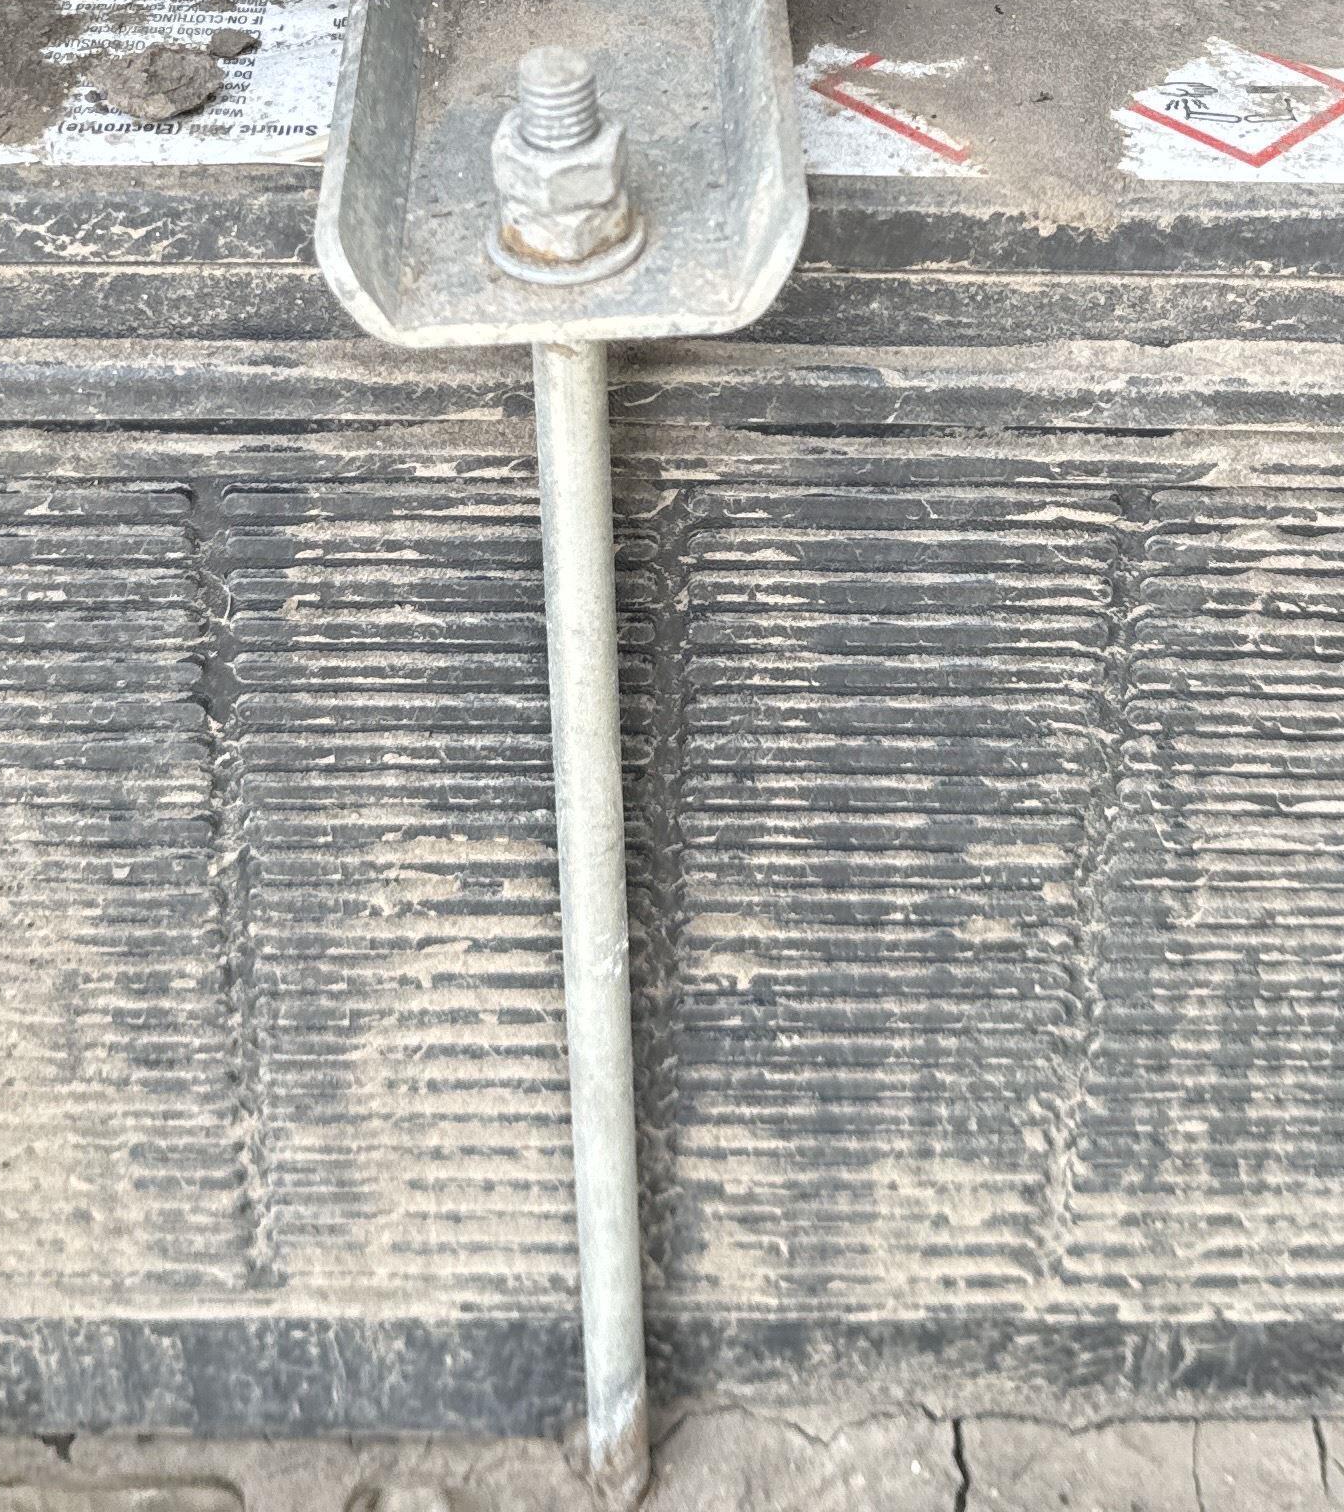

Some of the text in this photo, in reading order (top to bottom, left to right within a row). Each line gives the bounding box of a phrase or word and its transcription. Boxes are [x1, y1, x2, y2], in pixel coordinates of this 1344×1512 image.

[227, 15, 248, 25] ON
[208, 107, 244, 118] Wear
[238, 123, 318, 137] Sulfuric
